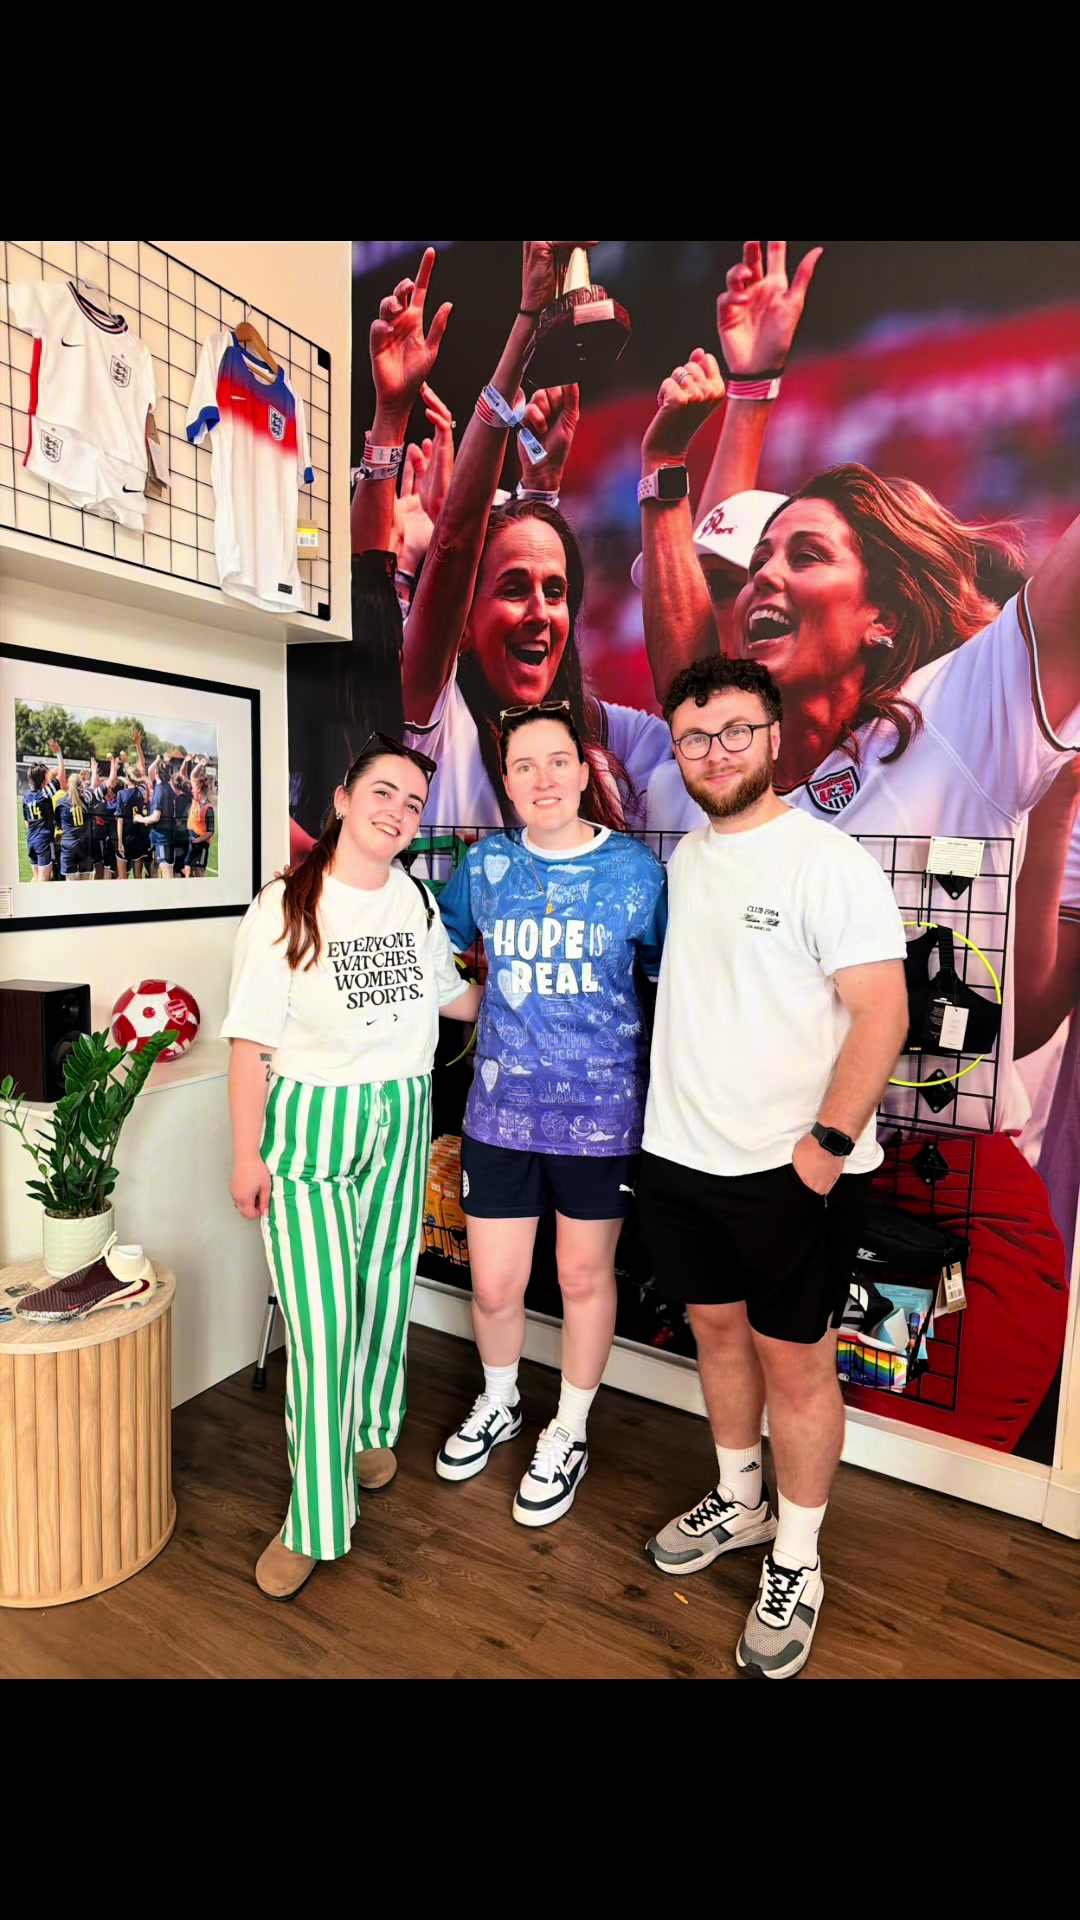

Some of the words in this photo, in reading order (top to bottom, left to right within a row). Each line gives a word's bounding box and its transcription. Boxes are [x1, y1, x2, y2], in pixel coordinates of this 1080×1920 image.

[28, 801, 42, 820] 14
[70, 805, 84, 826] 10
[327, 932, 415, 958] EVERYONE
[493, 917, 585, 960] HOPE
[589, 922, 604, 957] IS
[332, 950, 418, 974] WATCHES
[335, 965, 424, 991] WOMEN'S
[511, 960, 600, 995] REAL
[346, 983, 424, 1009] SPORTS.
[550, 1022, 576, 1032] YOU
[536, 1032, 591, 1049] BELONG
[550, 1049, 581, 1060] HERE
[538, 1091, 586, 1103] CAPABLE
[556, 1081, 571, 1092] AM
